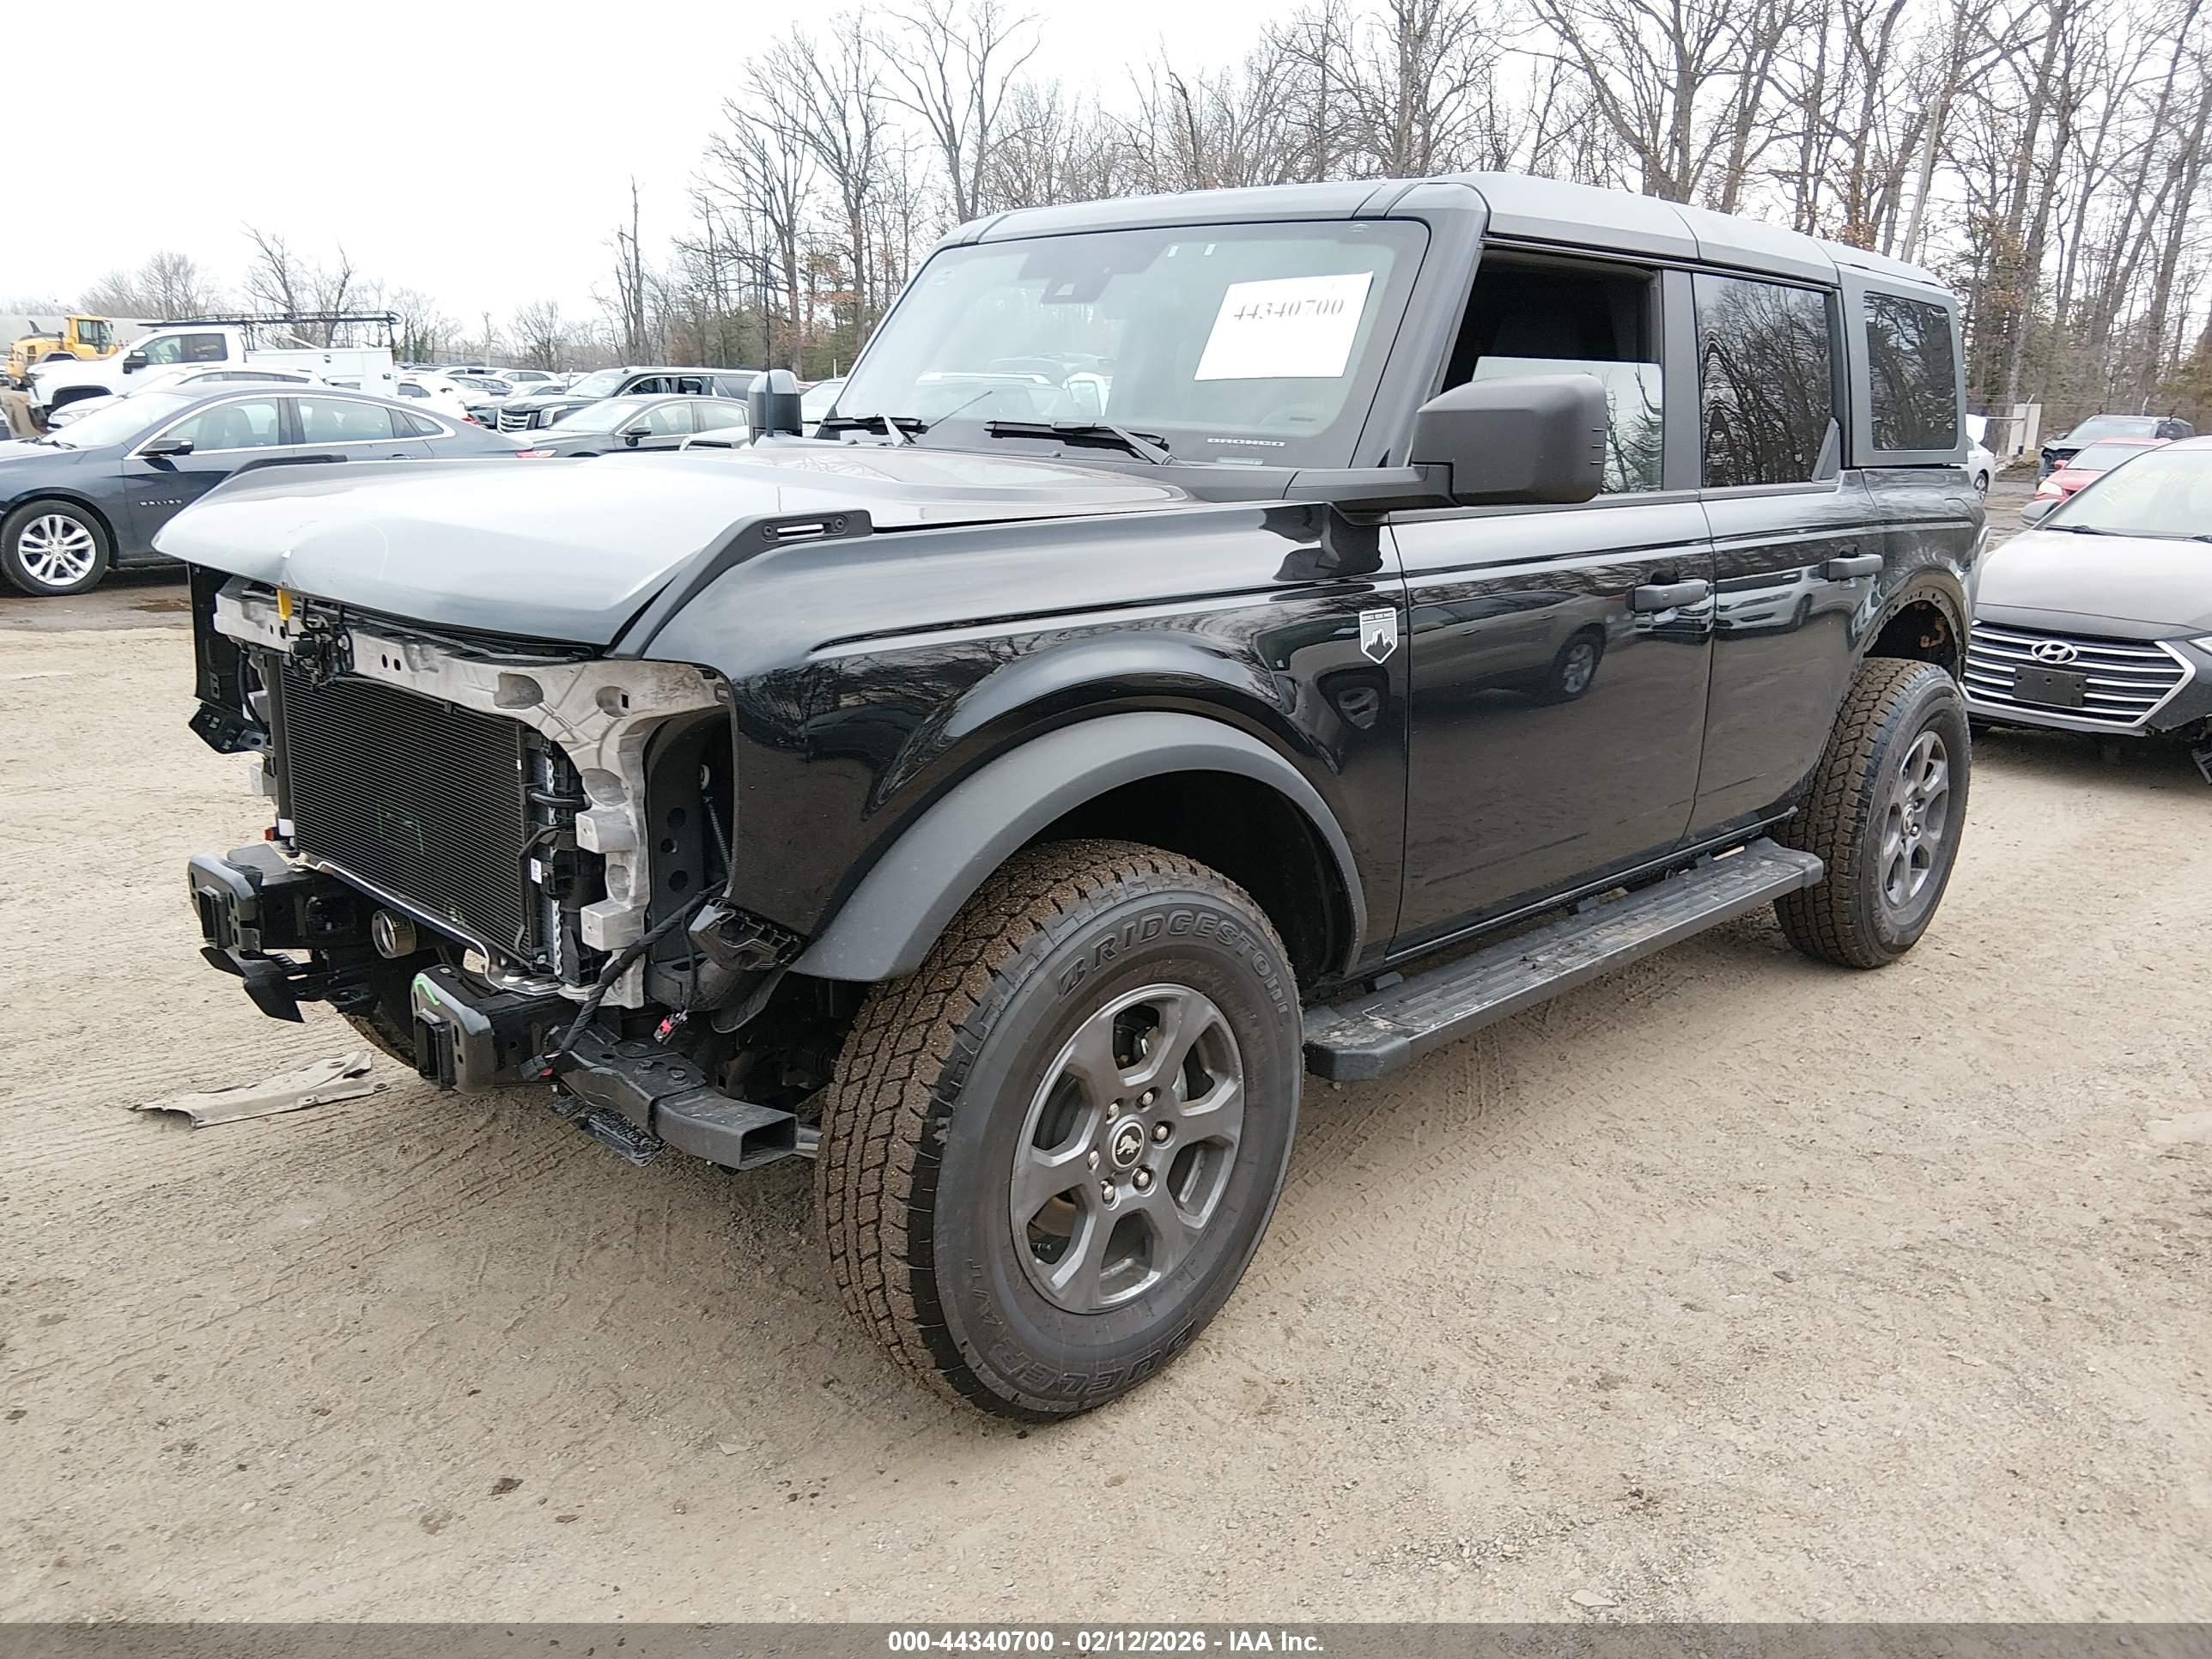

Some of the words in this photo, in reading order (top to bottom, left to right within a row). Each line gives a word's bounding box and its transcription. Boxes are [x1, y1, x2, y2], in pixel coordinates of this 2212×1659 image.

[1233, 299, 1345, 320] 44340700
[1206, 437, 1285, 447] BRONCO
[1057, 909, 1291, 1027] BRIDGESTONE
